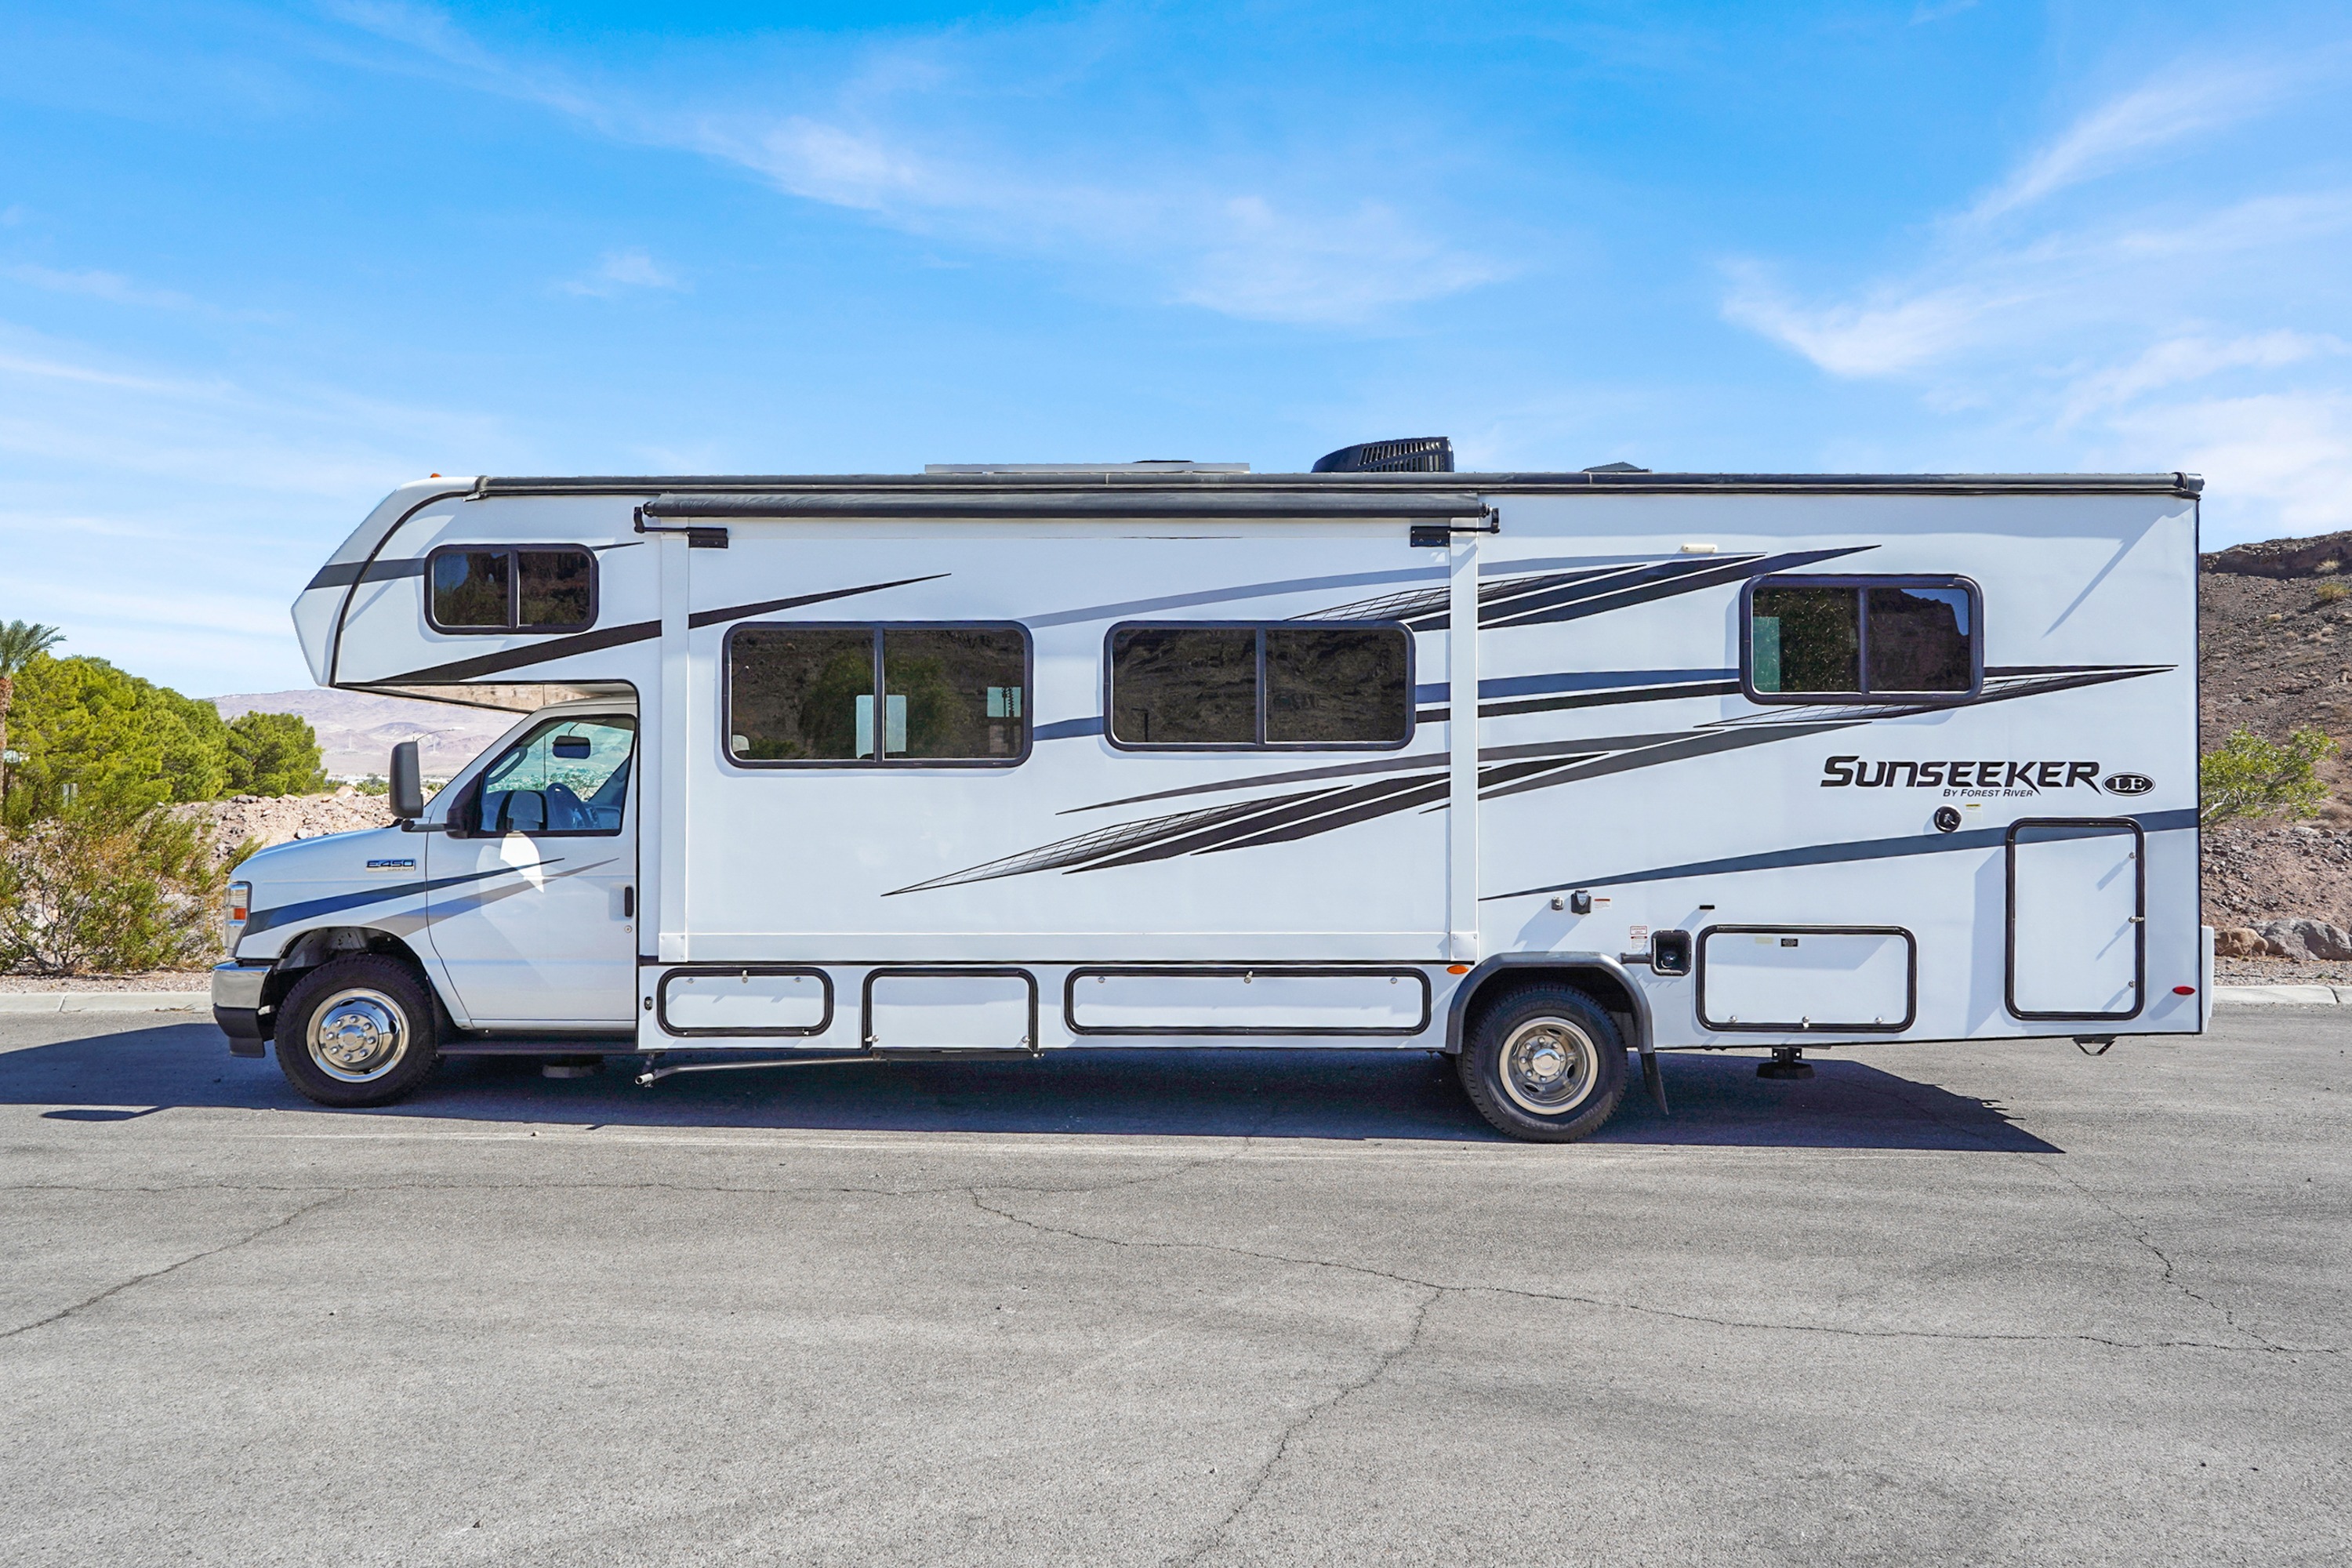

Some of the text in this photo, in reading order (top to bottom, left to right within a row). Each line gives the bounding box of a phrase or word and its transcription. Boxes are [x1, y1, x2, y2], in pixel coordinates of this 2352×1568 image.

[1820, 755, 2102, 796] SUNSEEKER
[2112, 777, 2147, 792] LE
[1943, 789, 2034, 797] BY FOREST RIVER
